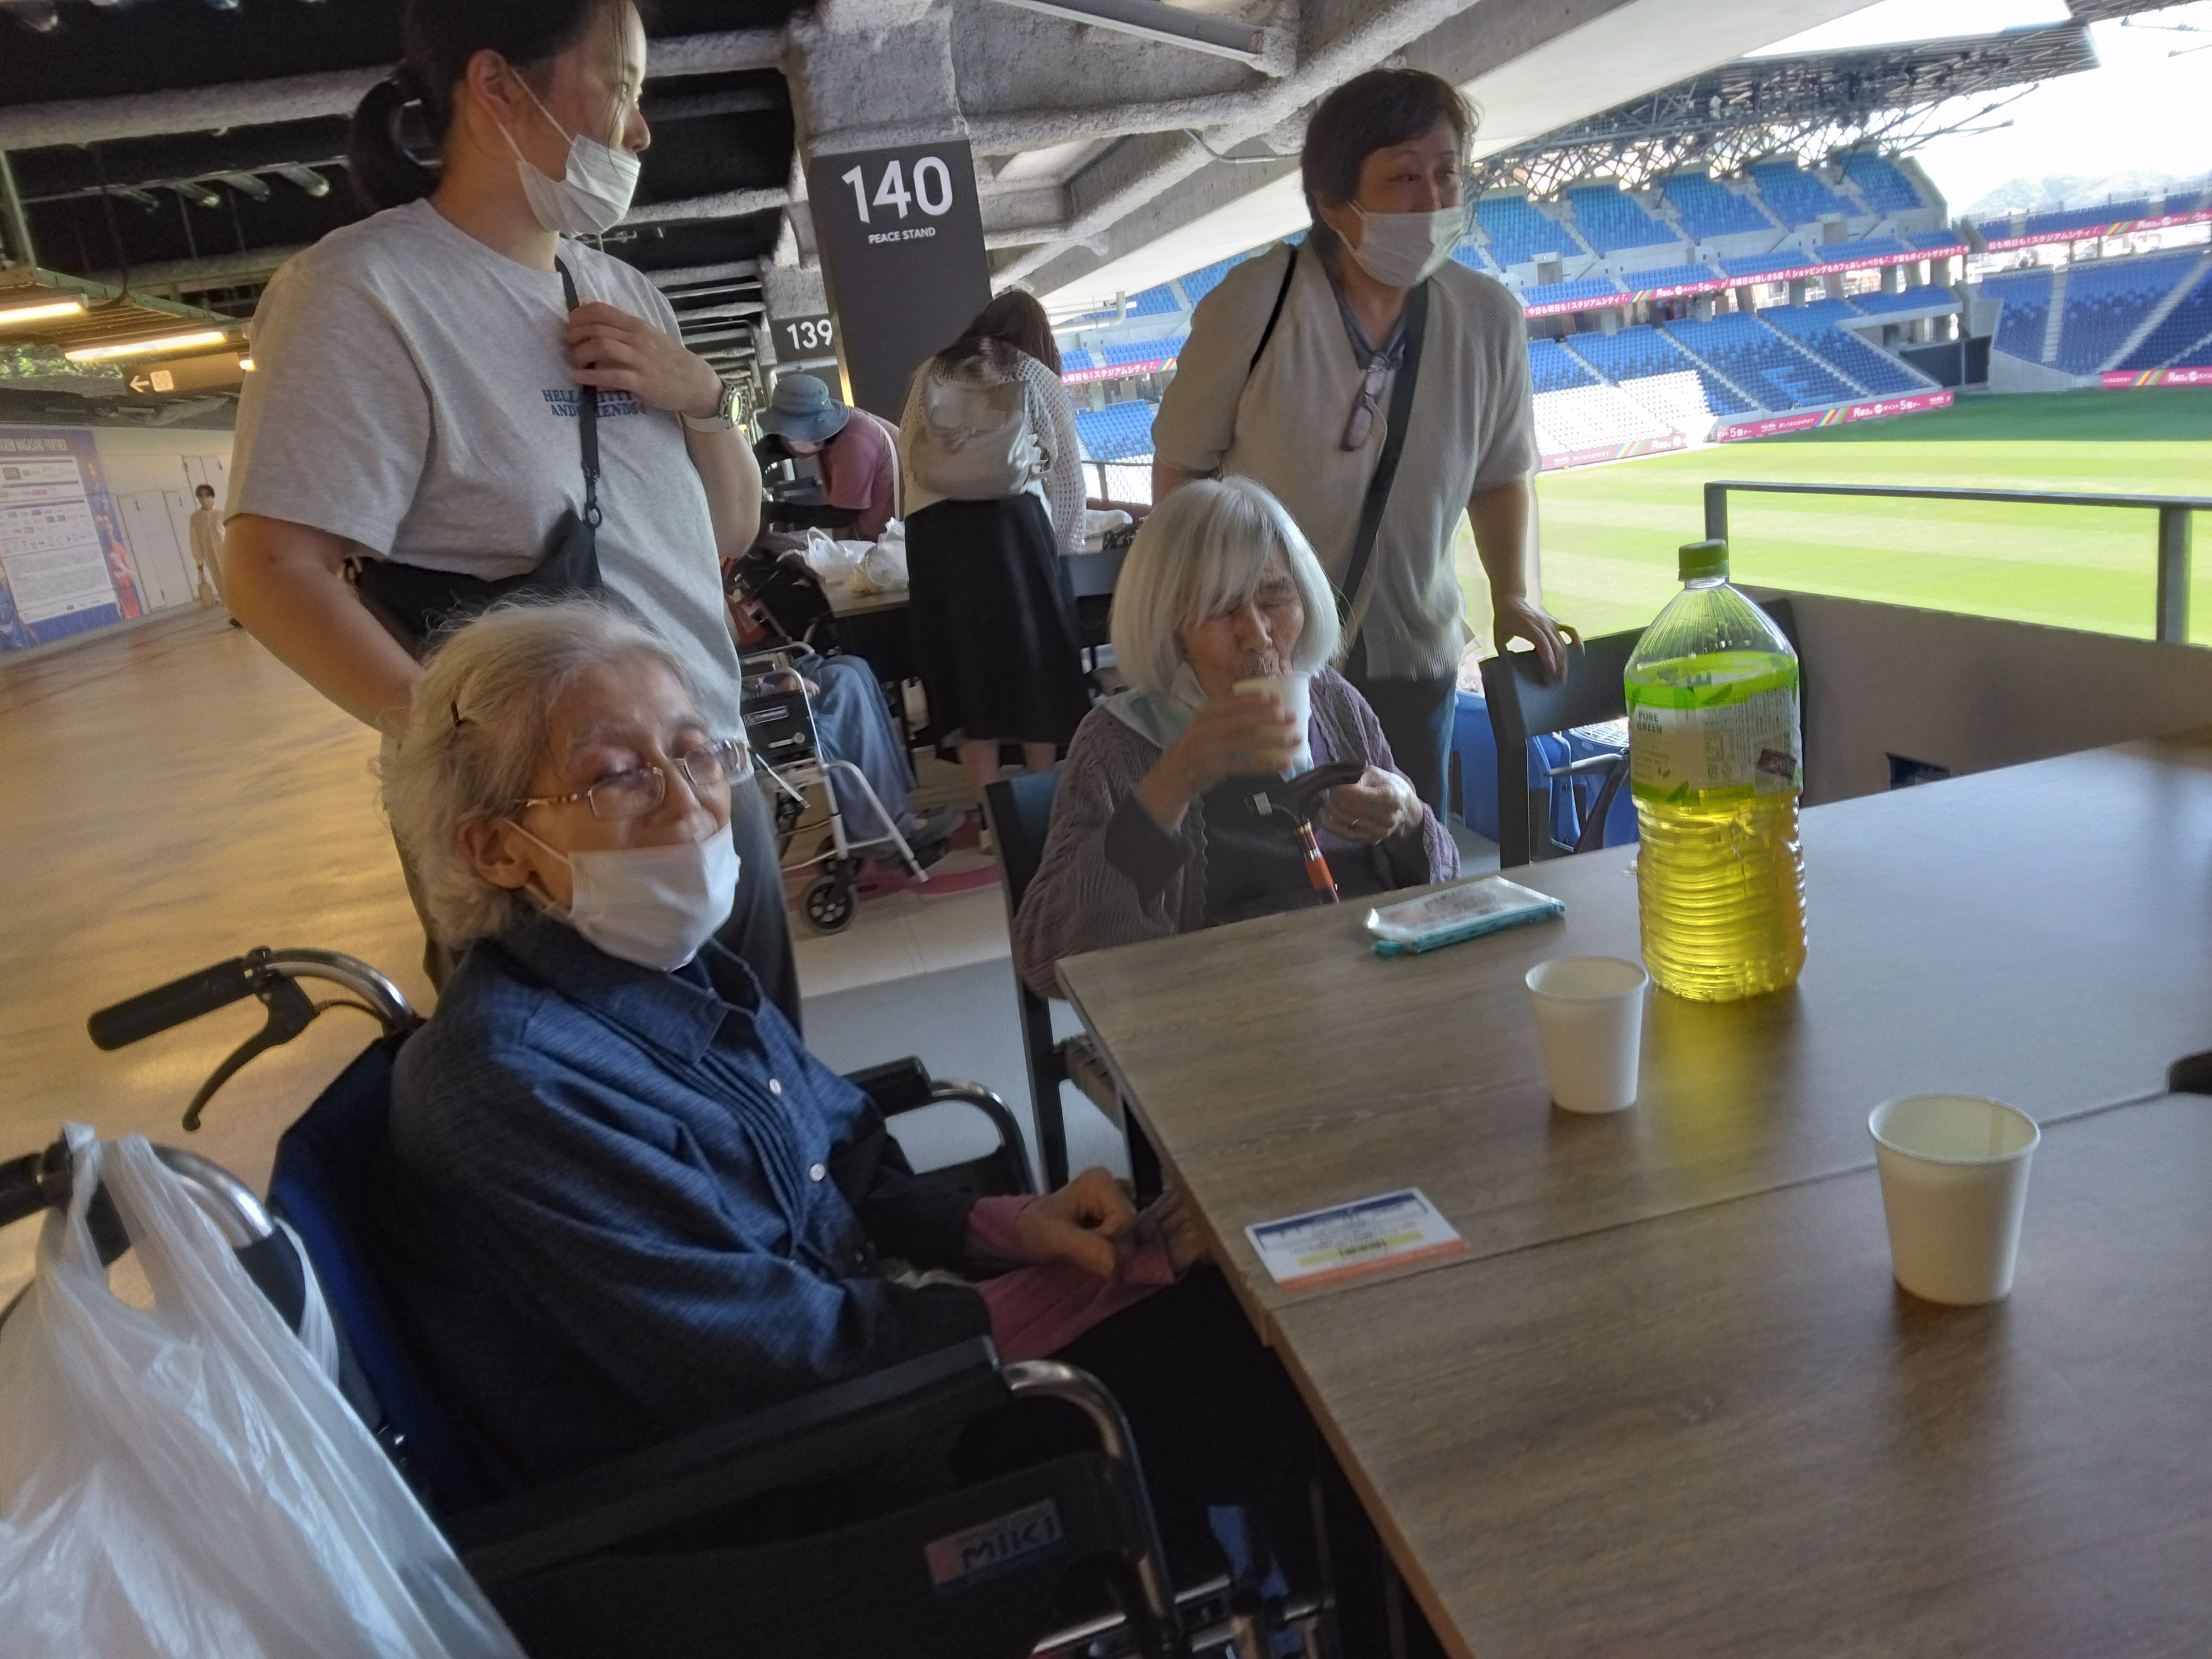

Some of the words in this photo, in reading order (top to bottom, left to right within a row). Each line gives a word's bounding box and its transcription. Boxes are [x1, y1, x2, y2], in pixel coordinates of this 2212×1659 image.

[841, 155, 953, 224] 140
[868, 231, 900, 244] PEACE
[902, 226, 937, 240] STAND
[786, 319, 832, 351] 139
[550, 404, 576, 416] AND
[1638, 710, 1659, 722] PURE
[1637, 722, 1663, 735] GREEN
[961, 1516, 1055, 1570] MIKI
